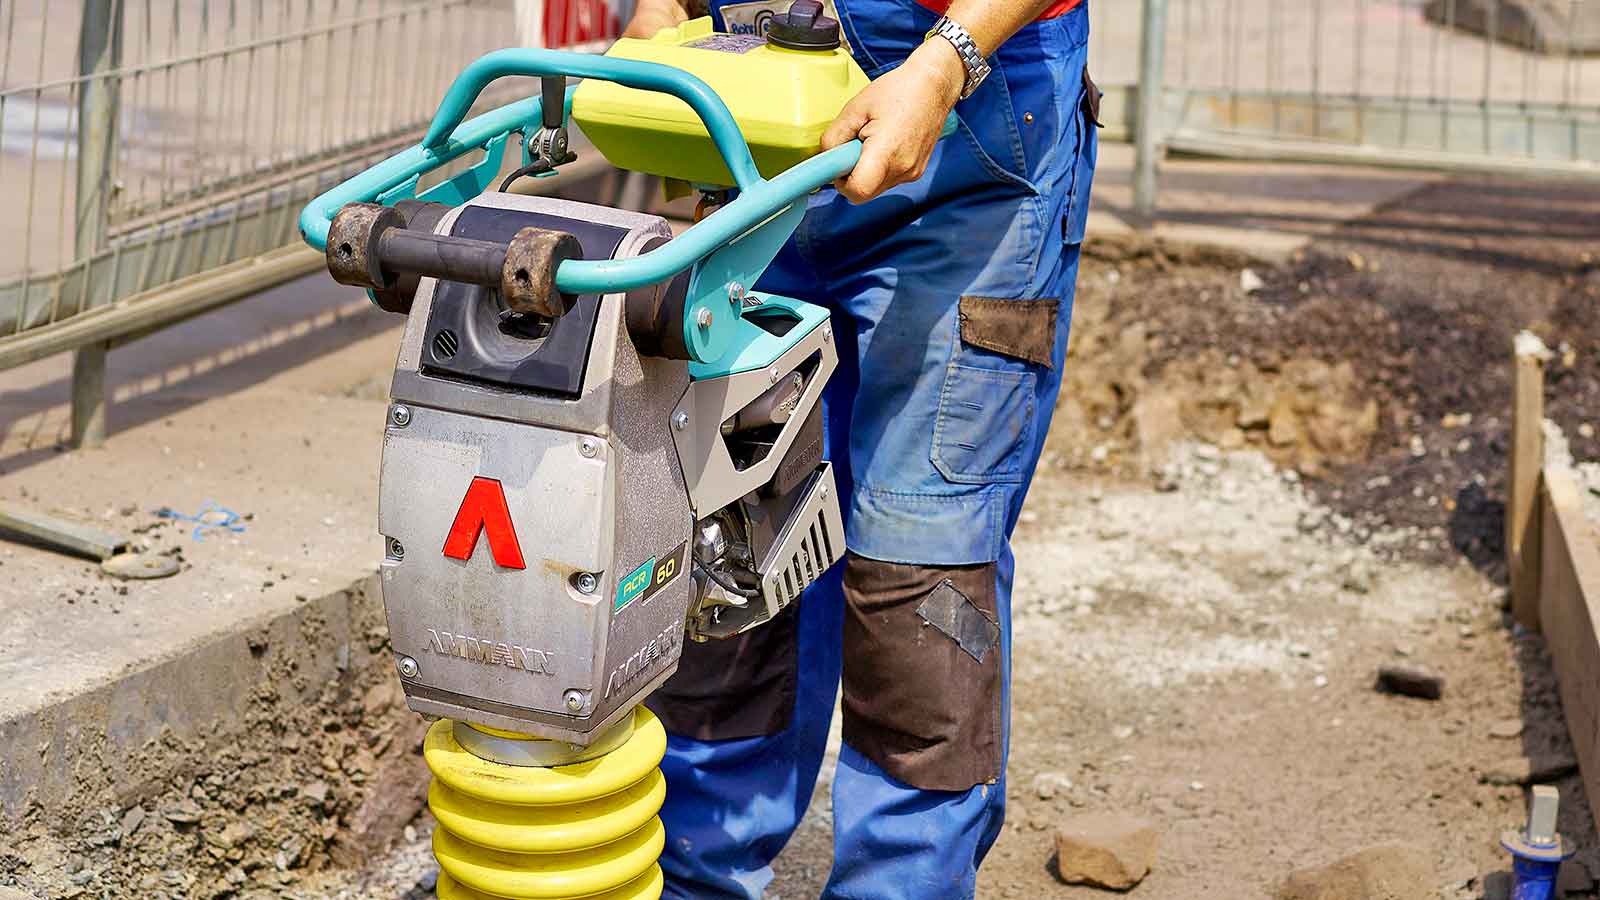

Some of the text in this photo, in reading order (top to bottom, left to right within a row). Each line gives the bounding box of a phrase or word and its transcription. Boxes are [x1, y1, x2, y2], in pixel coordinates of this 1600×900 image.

[623, 558, 675, 597] ACR 60
[422, 628, 555, 676] AMMANN
